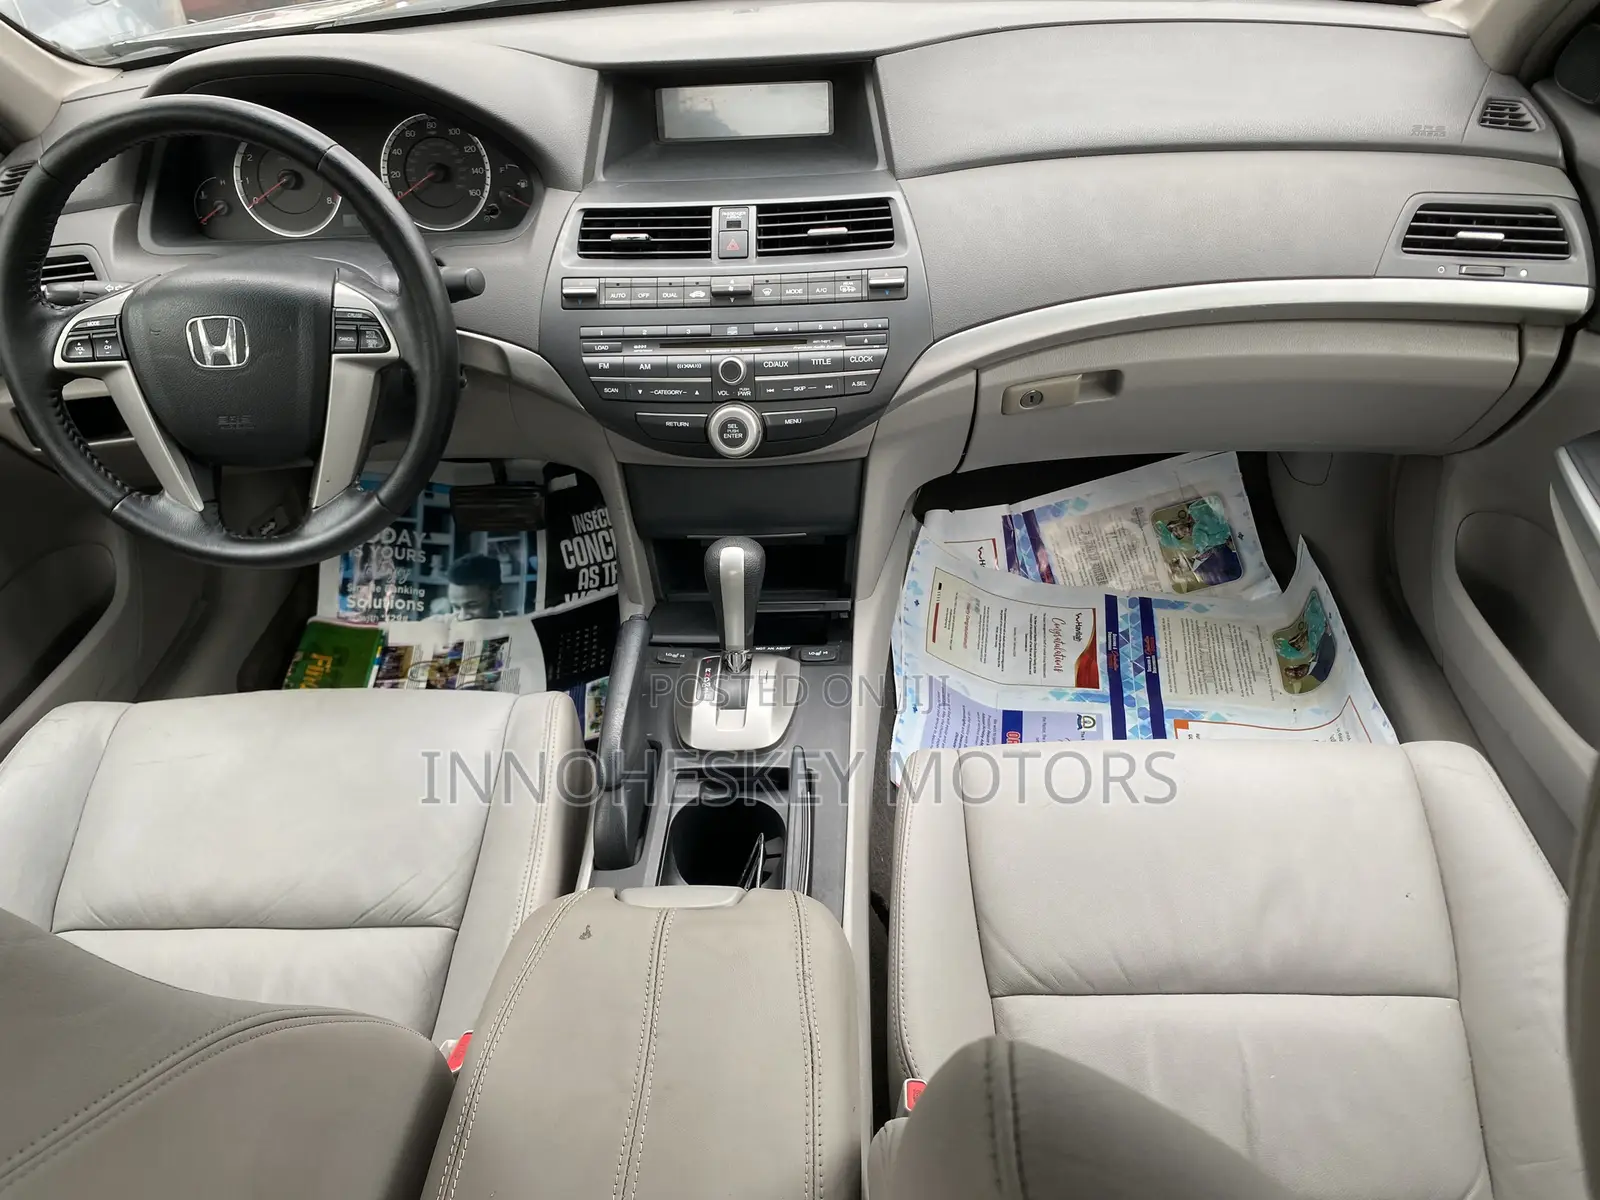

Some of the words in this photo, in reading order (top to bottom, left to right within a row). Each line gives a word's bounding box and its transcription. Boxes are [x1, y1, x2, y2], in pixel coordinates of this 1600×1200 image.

[367, 527, 426, 548] DAY
[371, 546, 426, 563] YOURS
[578, 565, 599, 590] AS
[1049, 618, 1066, 672] Congratulations
